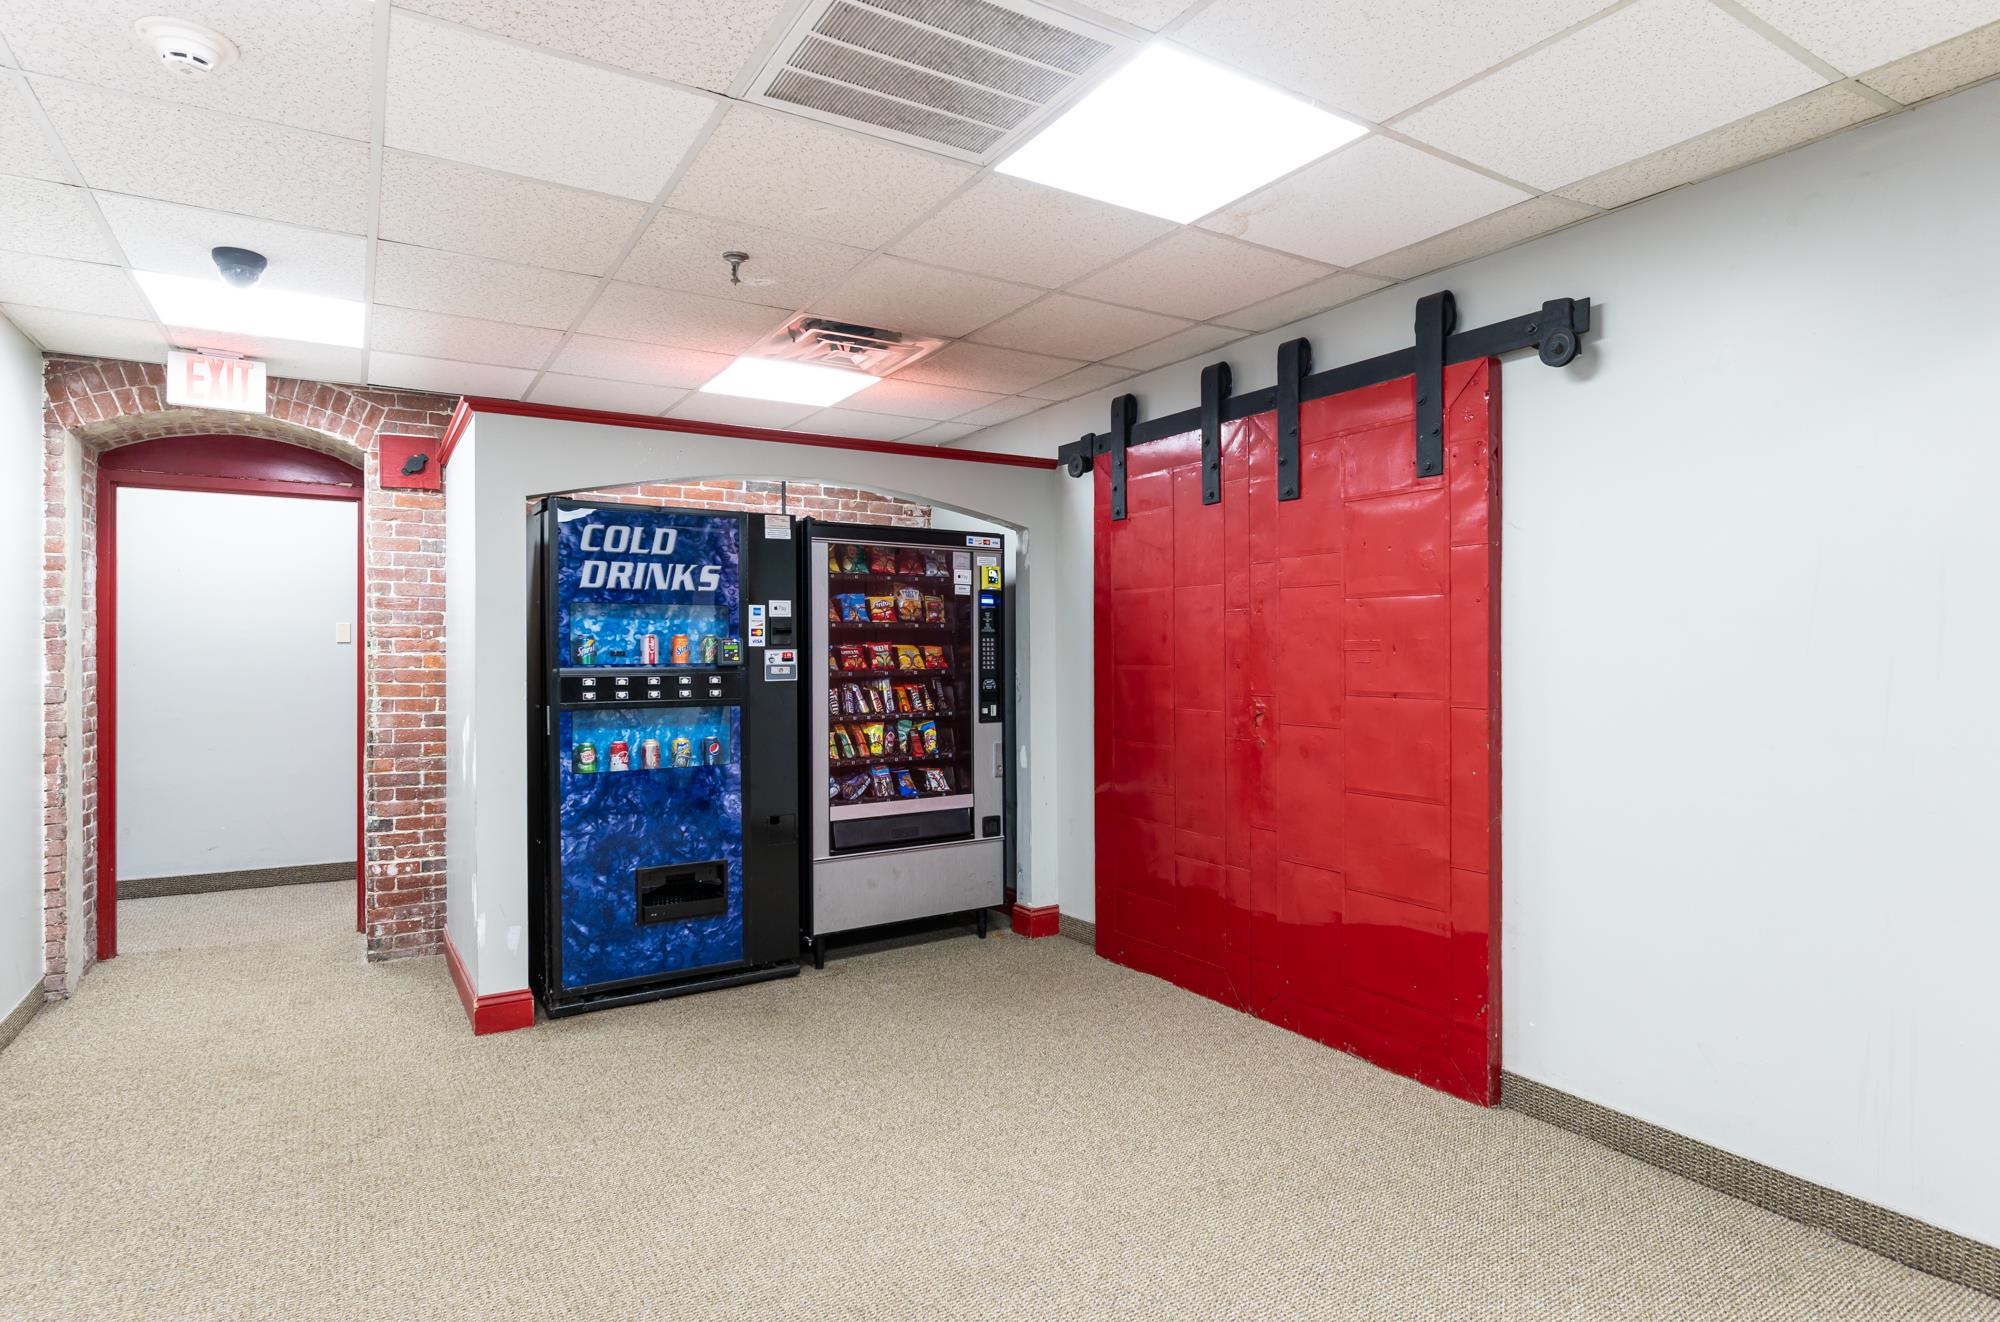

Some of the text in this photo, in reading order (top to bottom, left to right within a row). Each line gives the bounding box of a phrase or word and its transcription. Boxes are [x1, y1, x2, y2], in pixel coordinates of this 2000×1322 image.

[186, 355, 253, 403] EXIT
[580, 524, 678, 556] COLD
[579, 560, 722, 592] DRINKS
